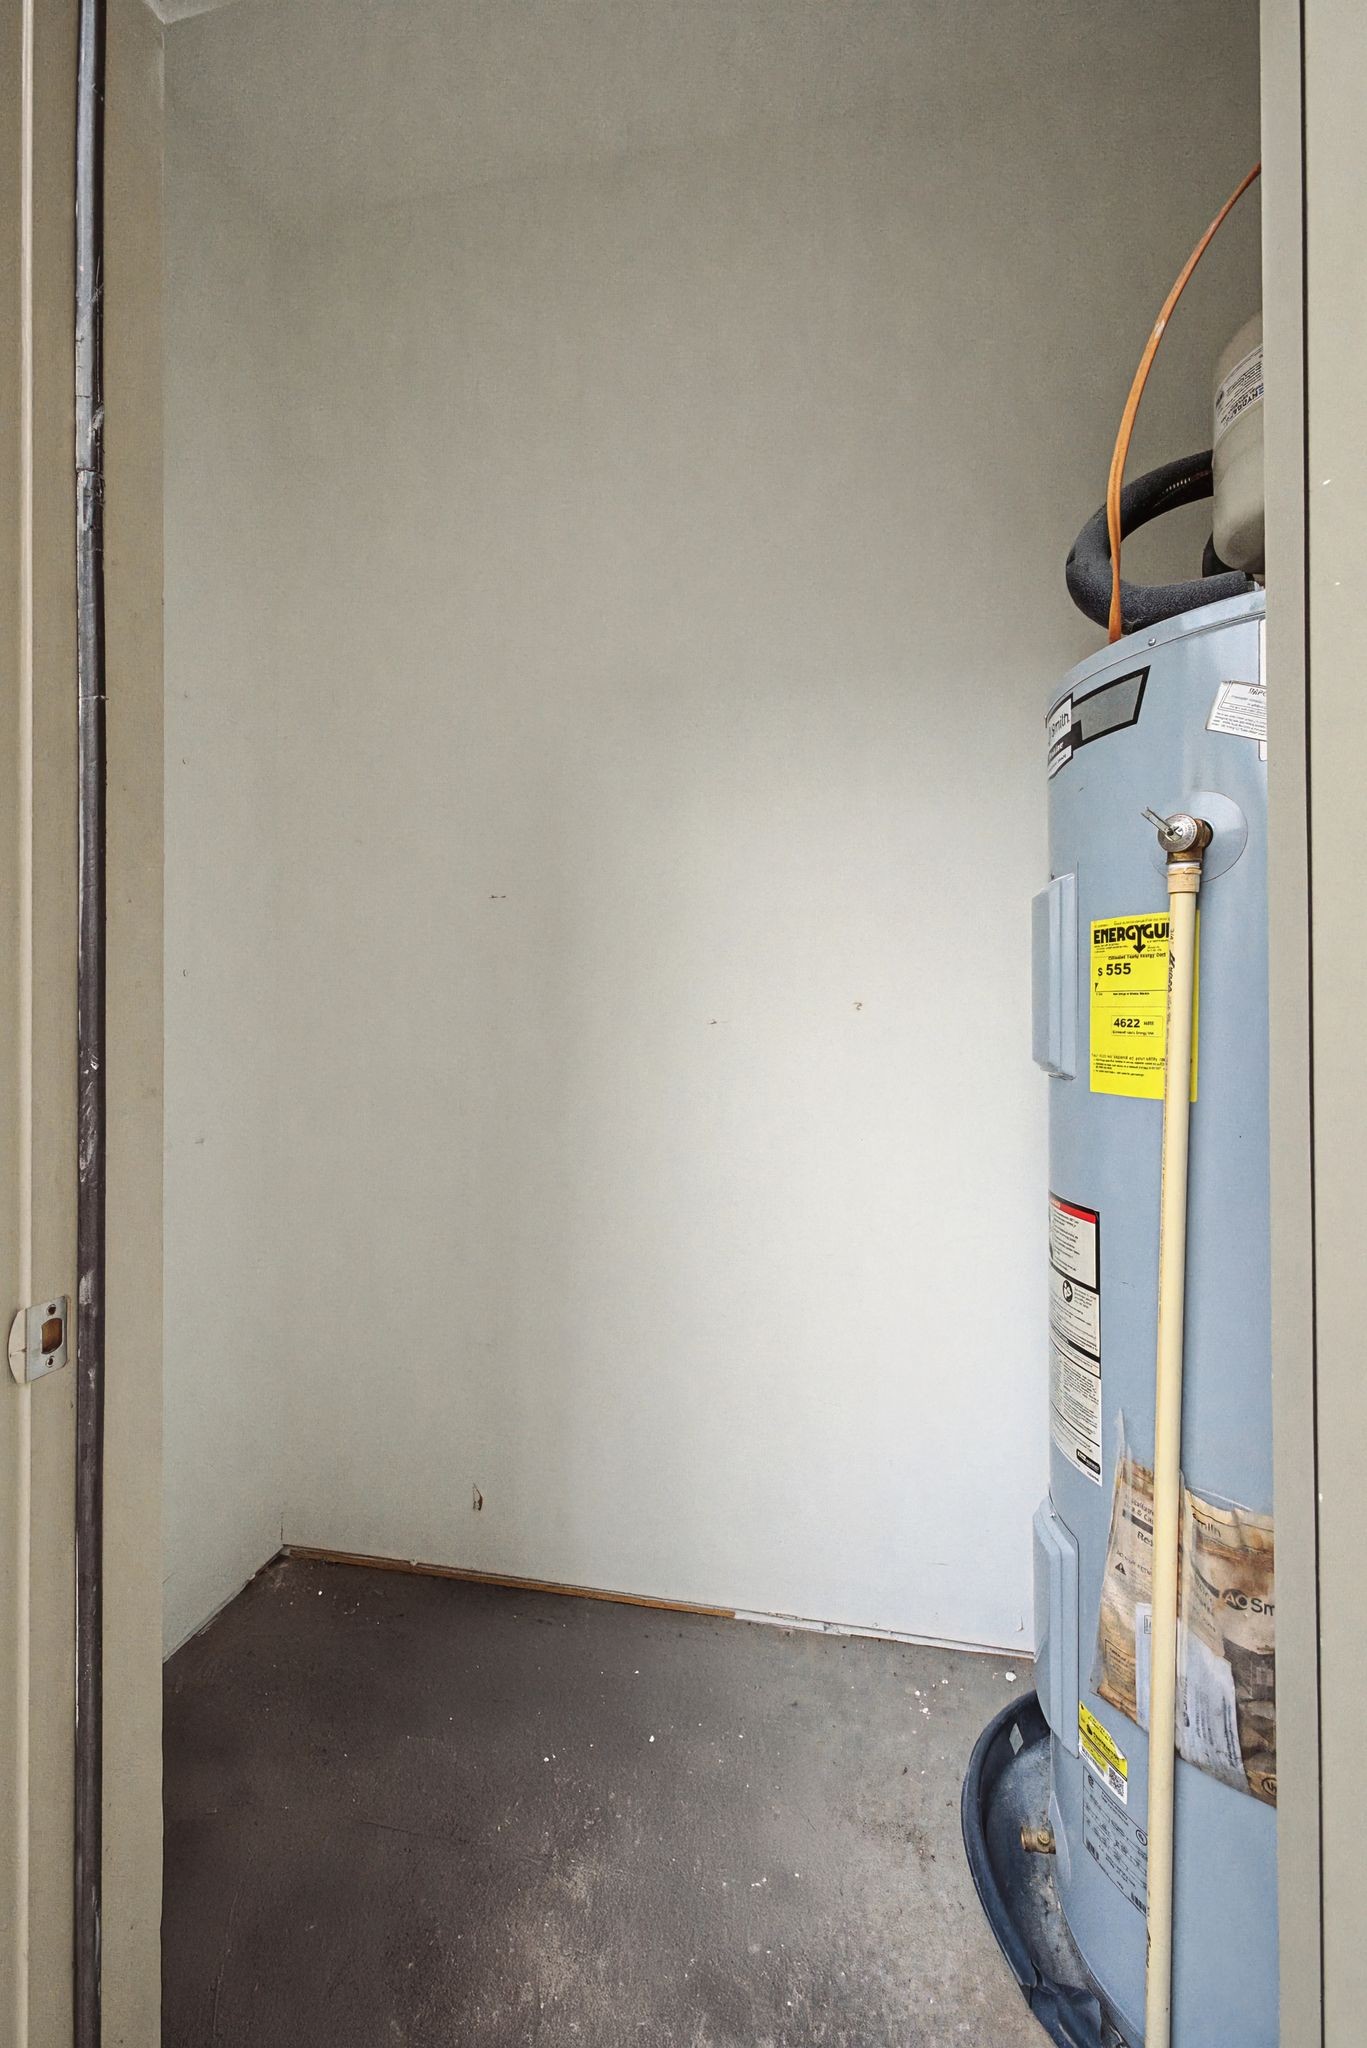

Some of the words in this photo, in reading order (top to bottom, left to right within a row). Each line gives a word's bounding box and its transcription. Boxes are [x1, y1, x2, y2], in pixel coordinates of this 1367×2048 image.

[1093, 922, 1170, 945] ENERGYGUI
[1097, 967, 1103, 977] $
[1105, 963, 1132, 976] 555
[1113, 1018, 1141, 1028] 4622
